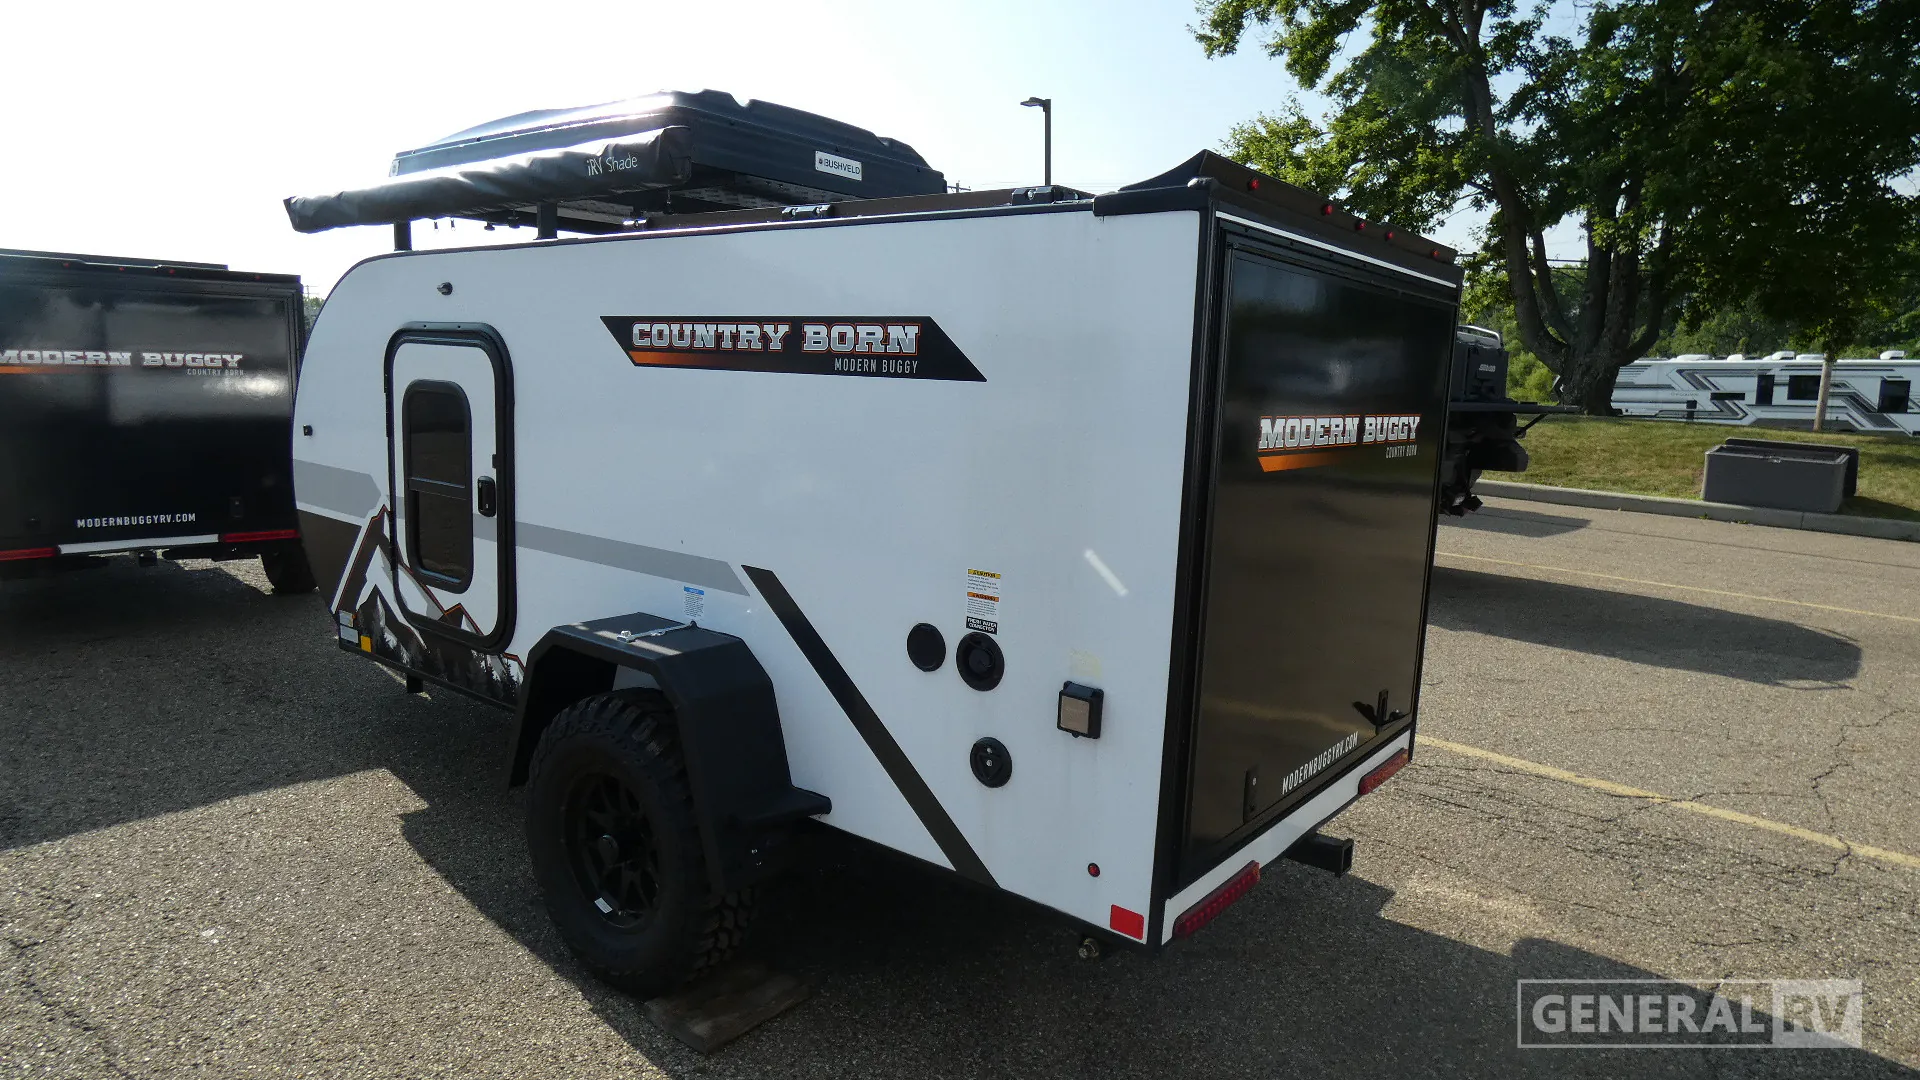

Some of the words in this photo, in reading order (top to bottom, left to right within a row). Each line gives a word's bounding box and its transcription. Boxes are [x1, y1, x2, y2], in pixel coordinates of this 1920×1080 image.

[586, 157, 603, 176] iRV
[606, 152, 638, 172] Shade
[824, 158, 861, 175] BUSHVELD
[632, 322, 791, 351] COUNTRY
[801, 323, 921, 354] BORN
[142, 353, 243, 367] BUGGY
[834, 357, 877, 373] MODERN
[882, 359, 919, 374] BUGGY
[187, 368, 222, 376] COUNTRY
[1258, 415, 1360, 451] MODERN
[1363, 414, 1421, 444] BUGGY
[76, 512, 196, 528] MODERNBUGGYRV.COM
[1281, 731, 1359, 795] MODERNBUGGYRV.COM
